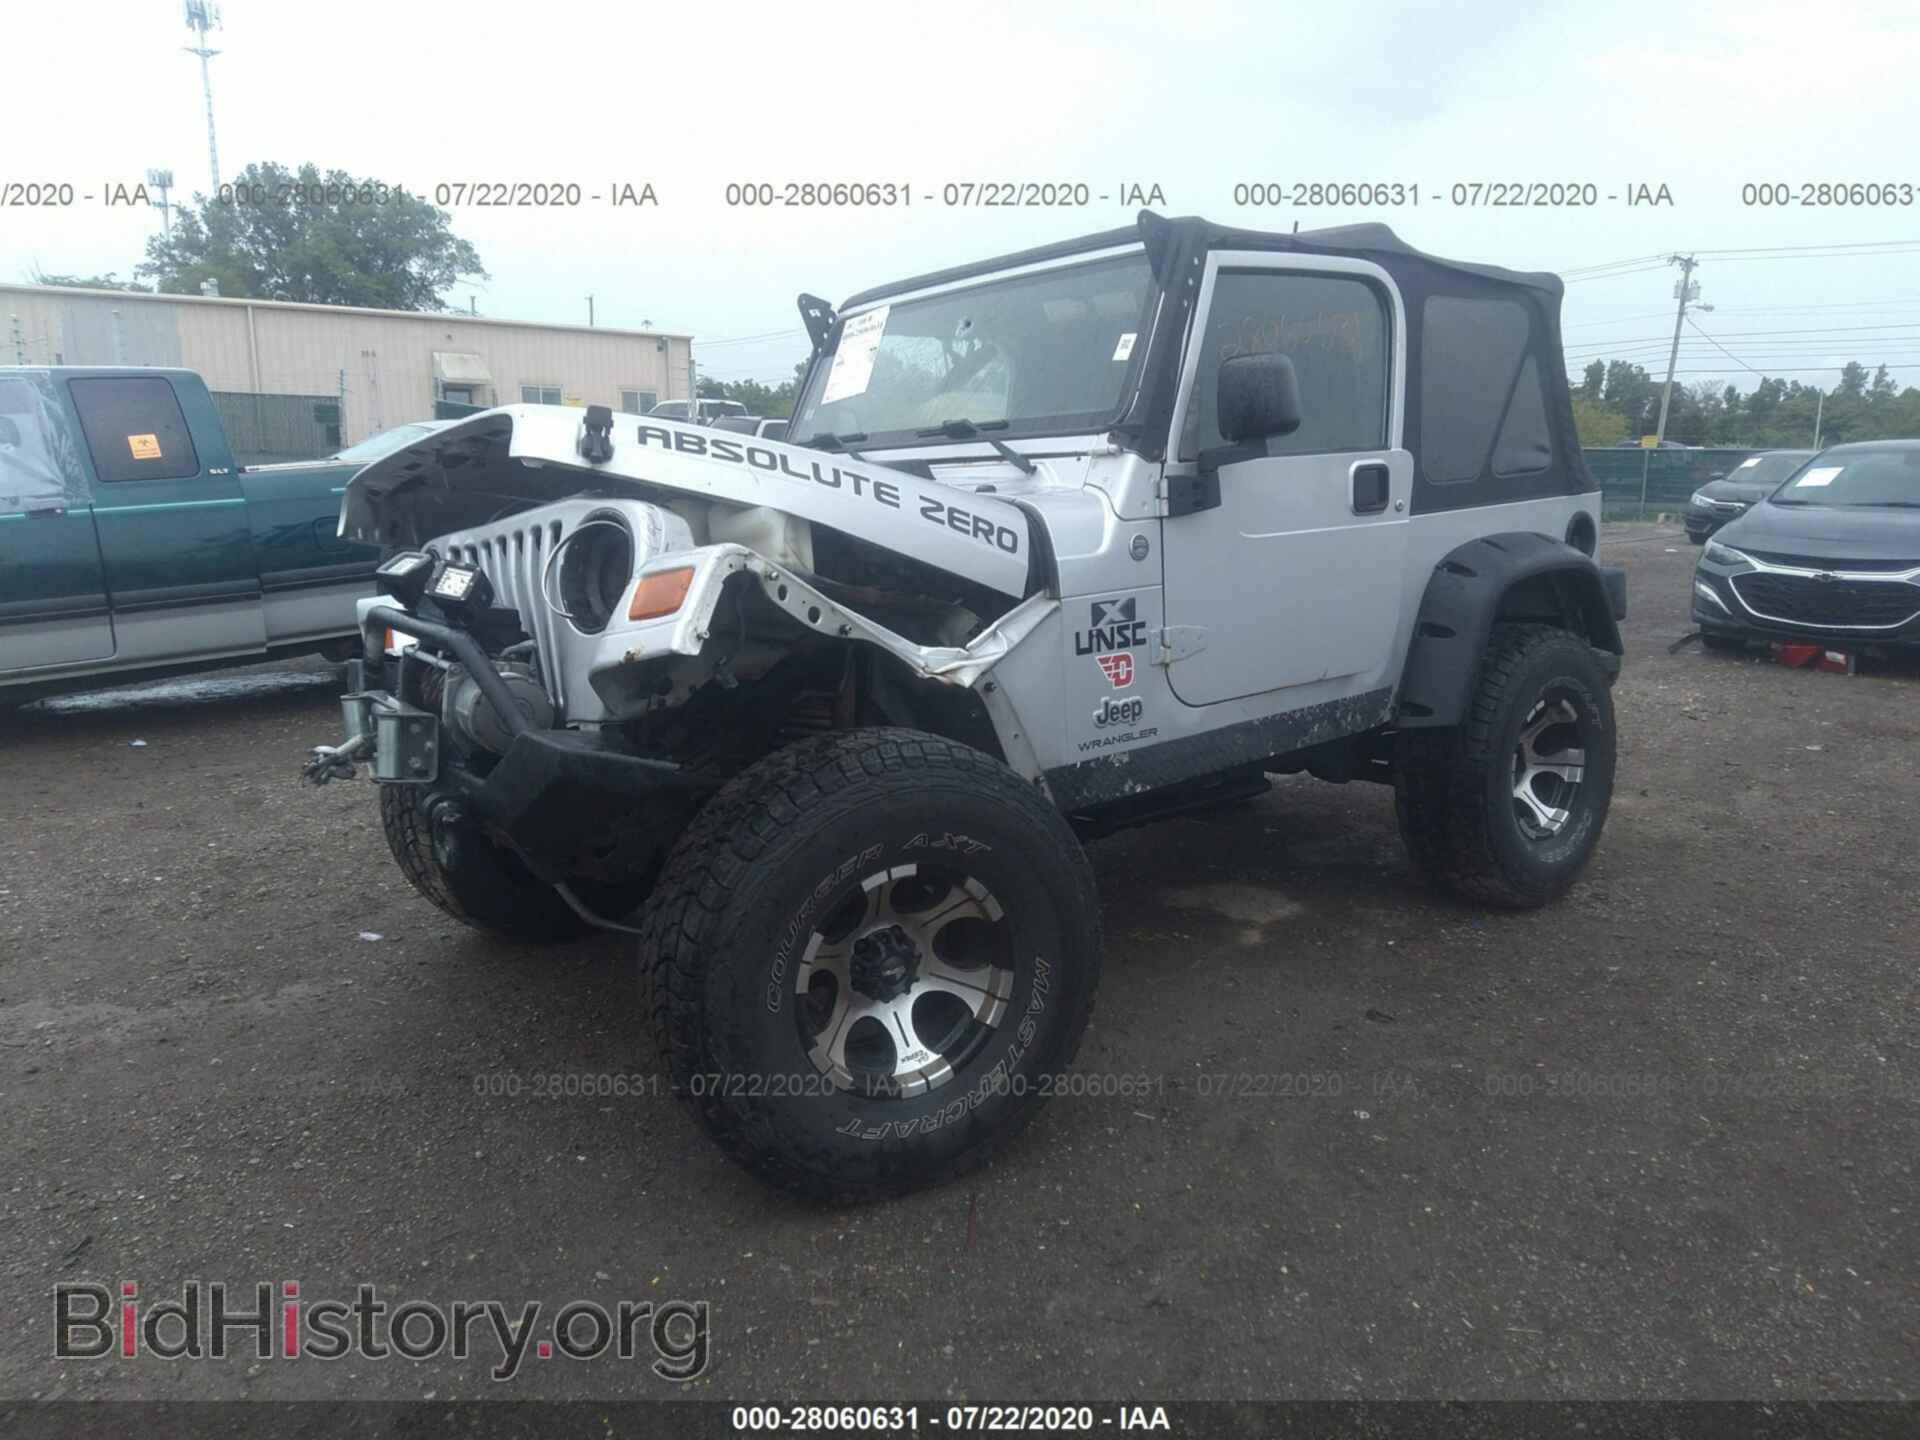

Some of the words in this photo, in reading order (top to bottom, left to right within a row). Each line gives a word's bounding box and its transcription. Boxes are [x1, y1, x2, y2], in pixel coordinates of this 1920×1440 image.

[637, 425, 901, 509] ABSOLUTE
[918, 495, 1038, 554] ZERO
[1075, 621, 1147, 656] UNSC
[1093, 697, 1143, 727] Jeep
[1078, 727, 1158, 752] WRANGLER
[835, 956, 1051, 1140] MASTERCRAFT
